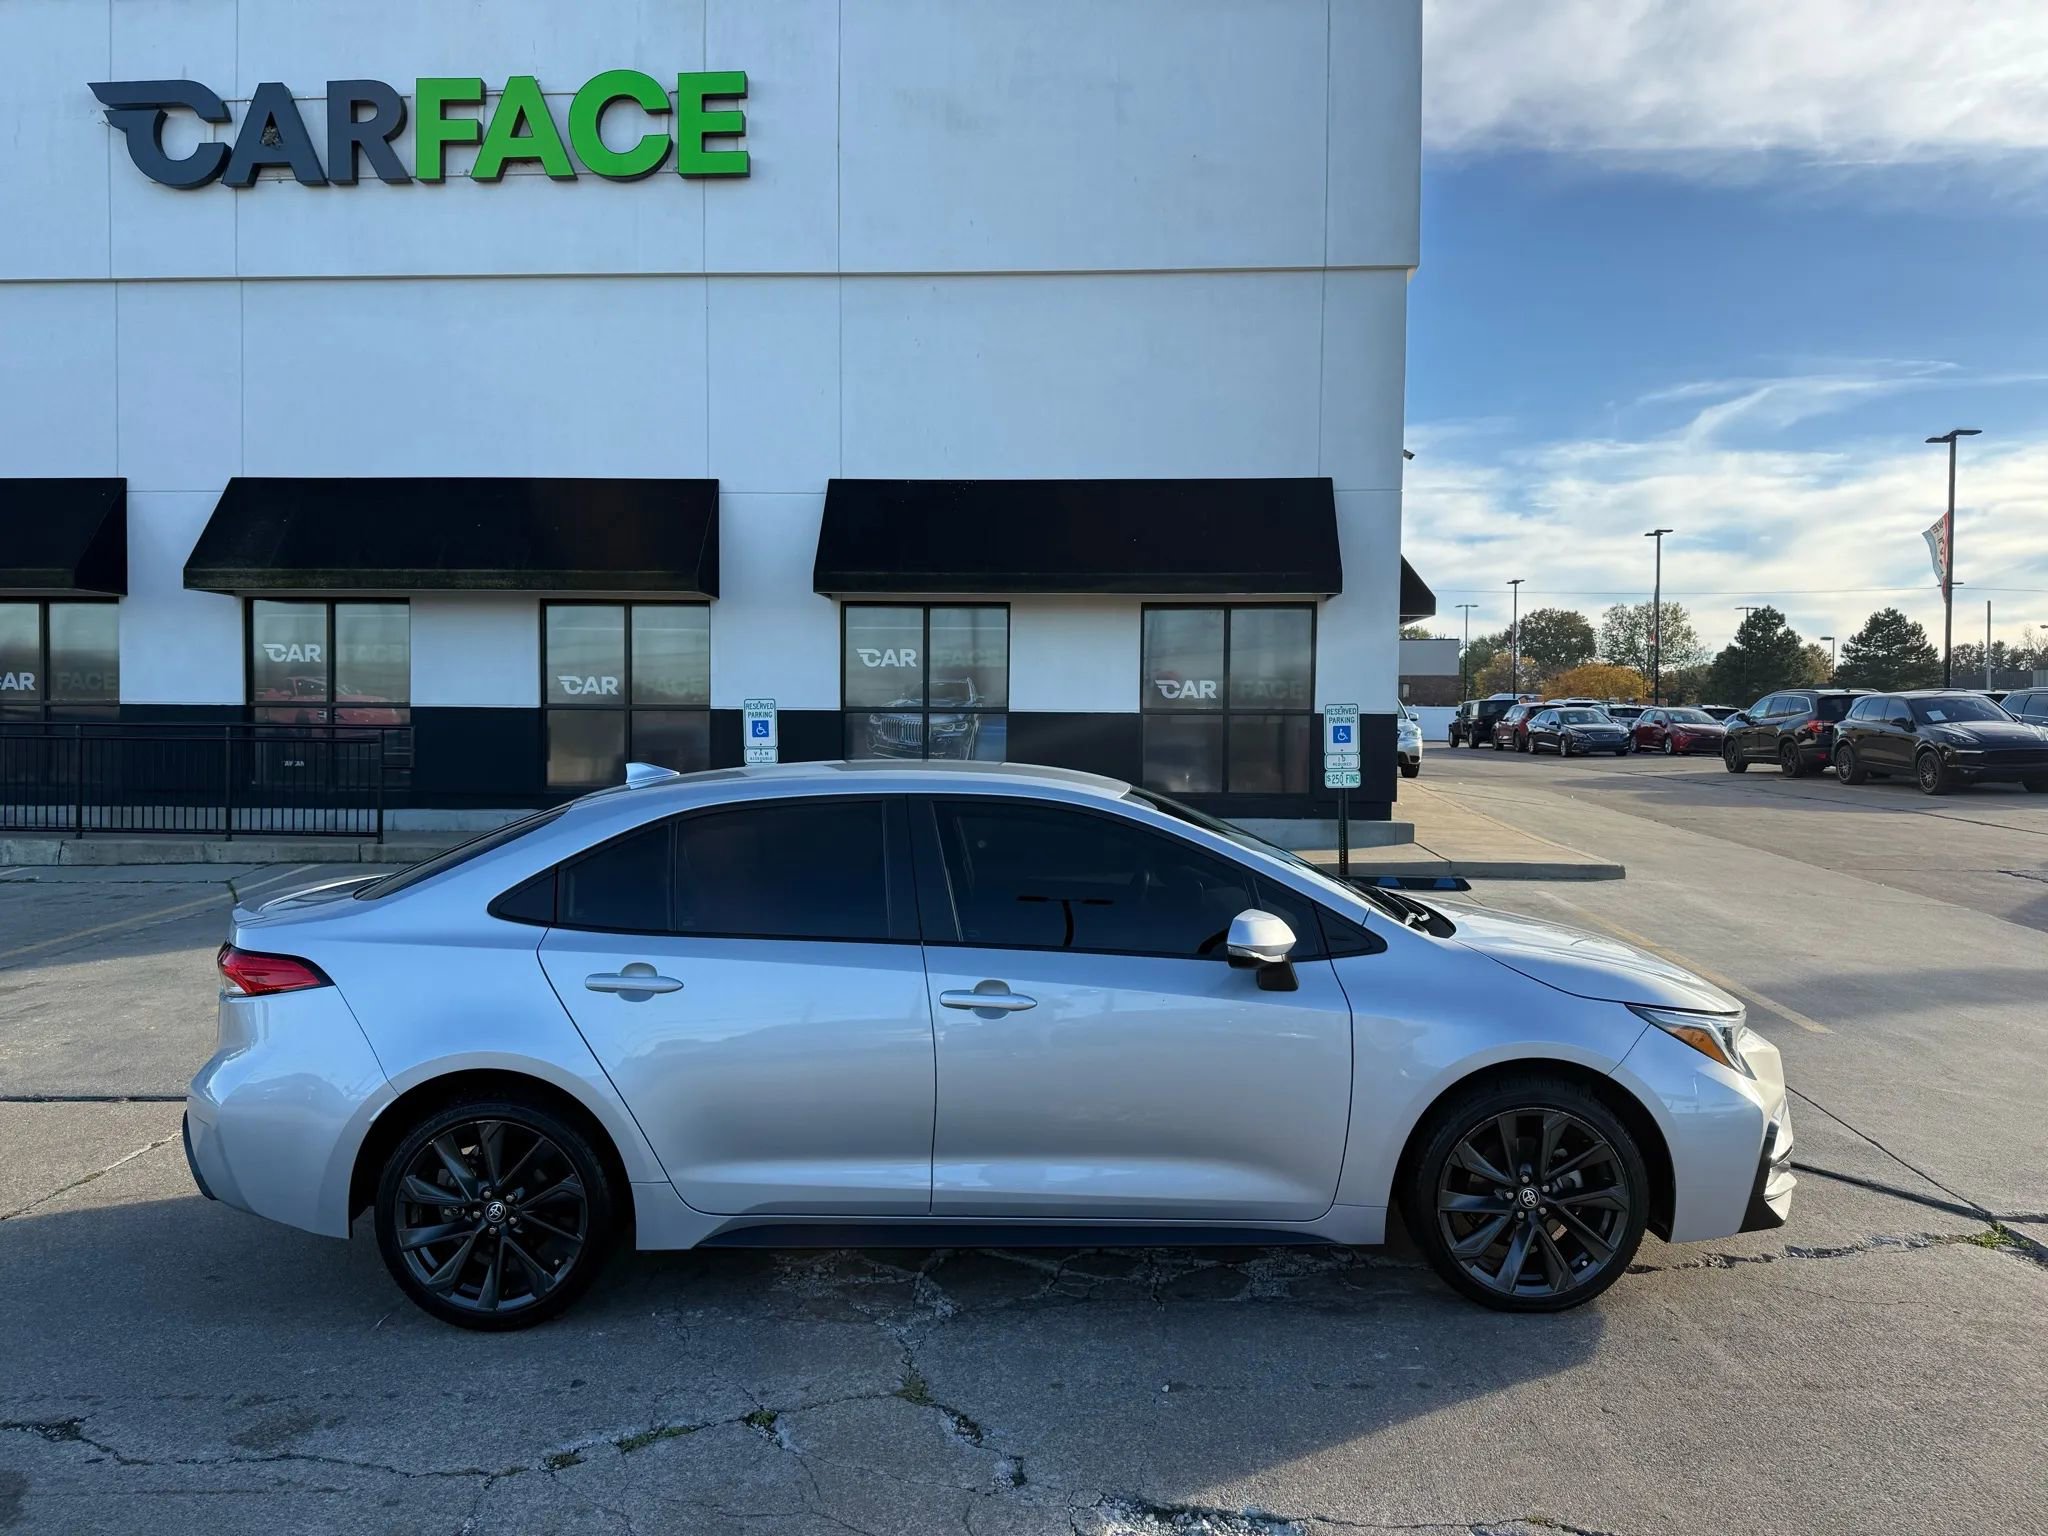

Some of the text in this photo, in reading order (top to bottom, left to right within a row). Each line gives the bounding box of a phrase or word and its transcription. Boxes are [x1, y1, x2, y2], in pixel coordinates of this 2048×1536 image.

[87, 69, 751, 189] CARFACE
[262, 643, 321, 663] CAR
[856, 648, 917, 668] CAR
[0, 672, 117, 690] AR FACE
[557, 675, 619, 695] CAR
[1154, 679, 1217, 699] CAR
[746, 702, 774, 710] RESERVED
[747, 711, 773, 719] PARKING
[1326, 707, 1357, 715] RESERVED
[1328, 716, 1355, 724] PARKING
[1326, 774, 1360, 784] $250 FINE
